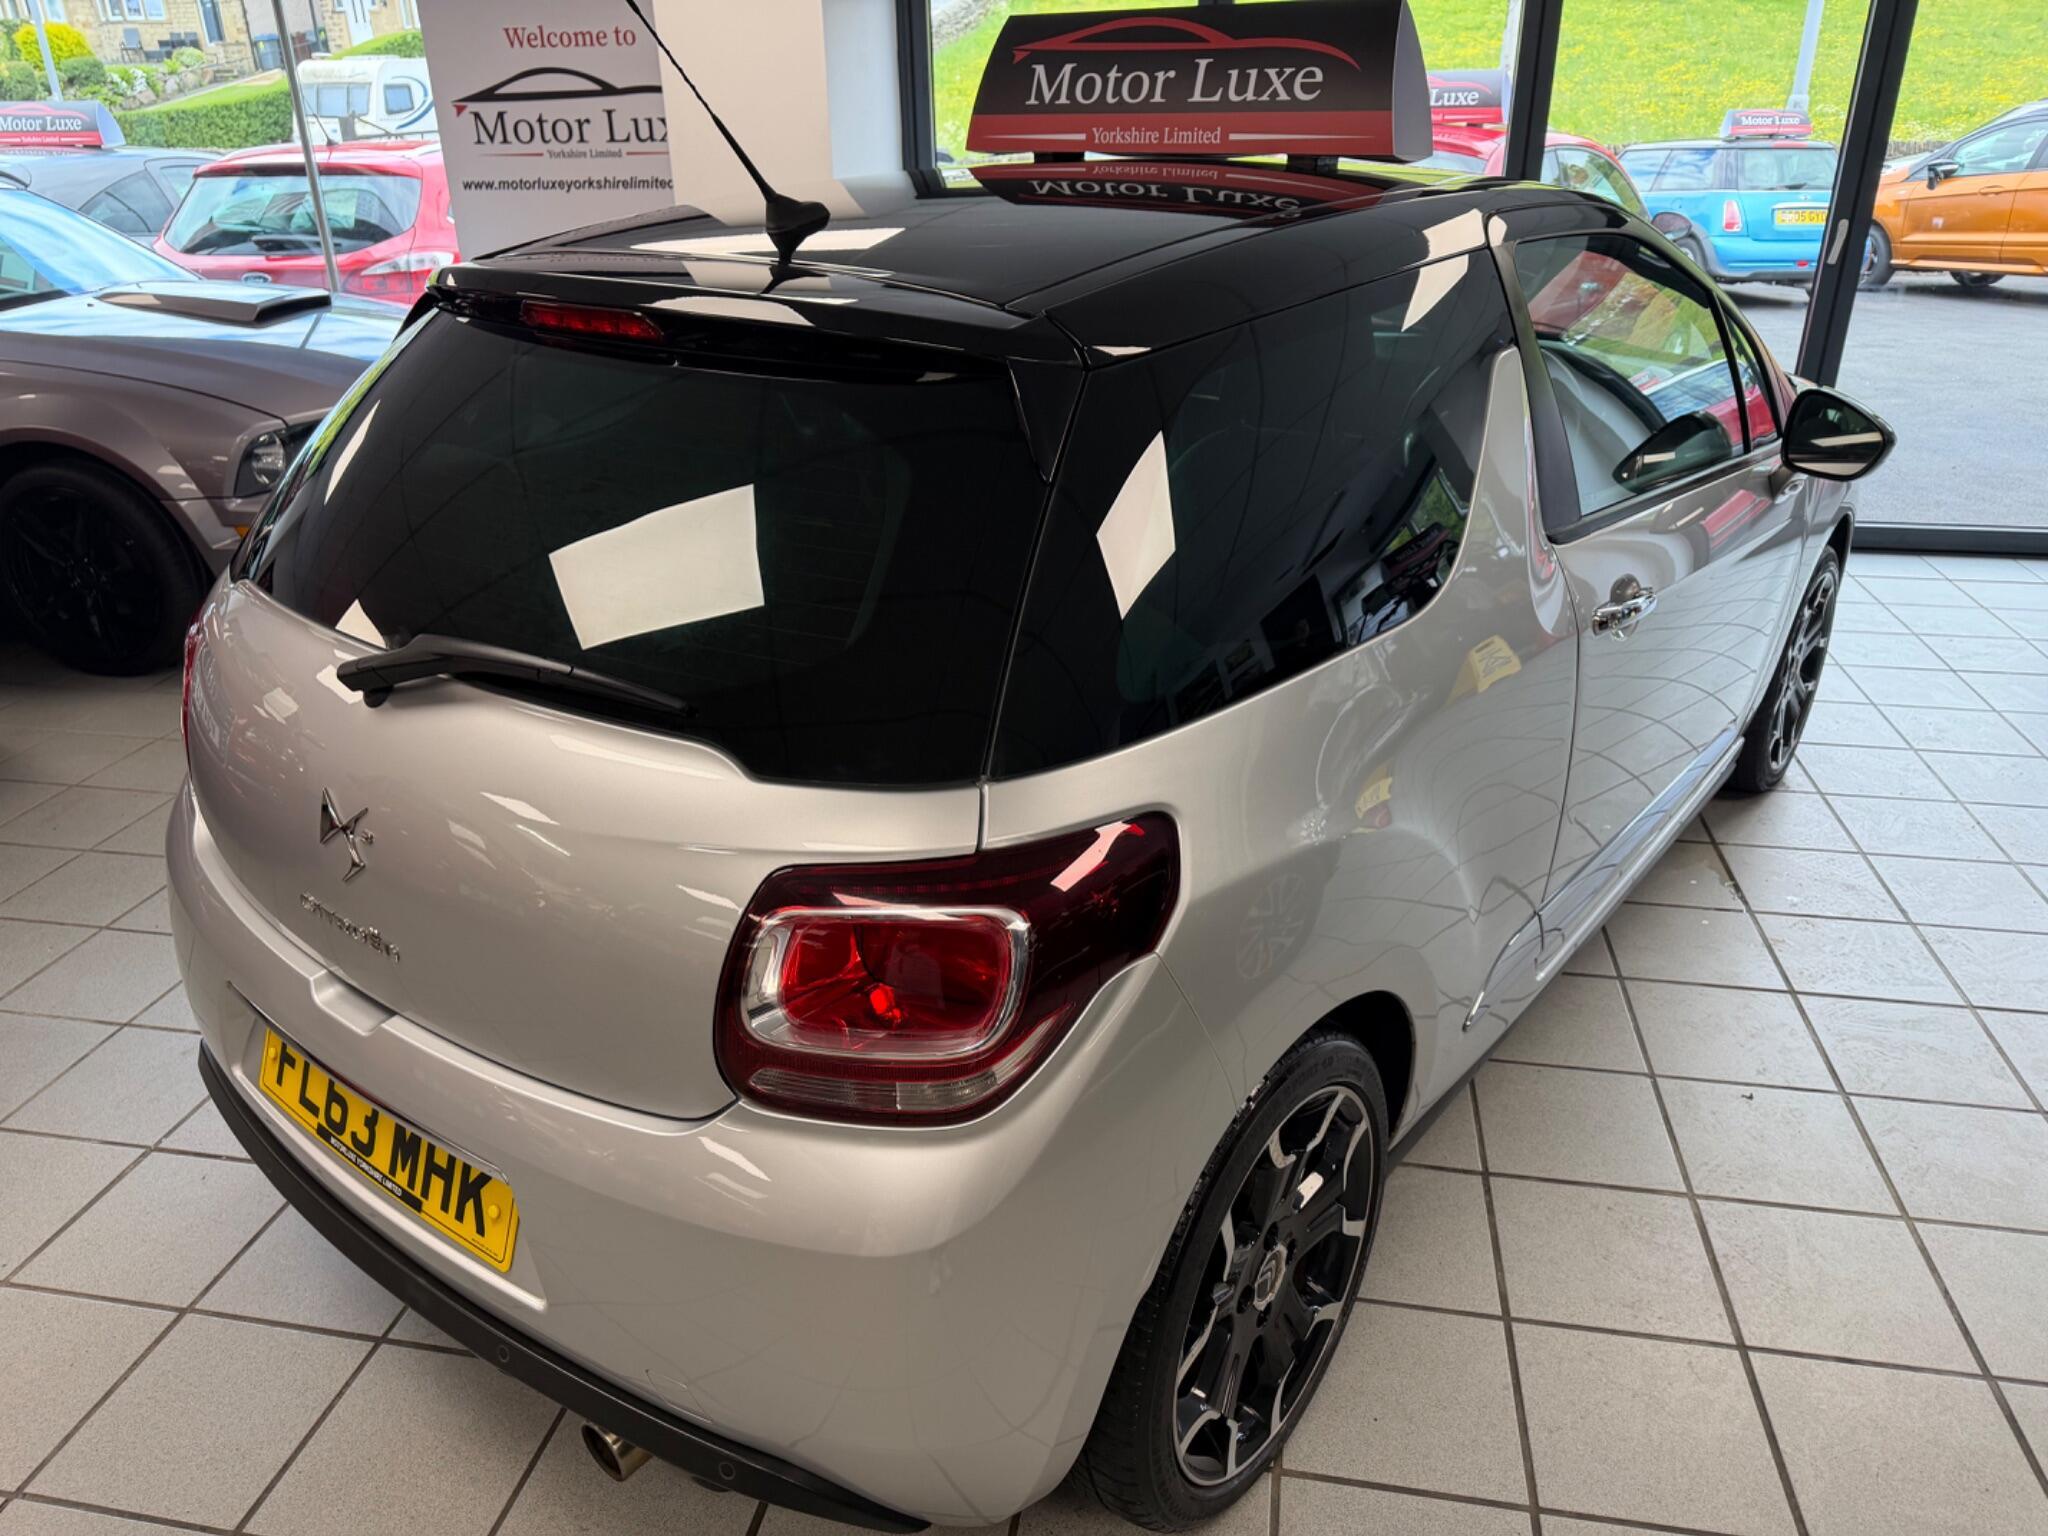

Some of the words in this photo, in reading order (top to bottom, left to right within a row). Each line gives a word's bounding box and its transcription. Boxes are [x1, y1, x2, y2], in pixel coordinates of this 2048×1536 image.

[504, 25, 608, 49] Welcome
[615, 25, 636, 46] to
[1025, 63, 1176, 105] Motor
[1187, 58, 1324, 102] Luxe
[1430, 88, 1480, 106] Luxe
[0, 115, 43, 131] Motor
[46, 115, 82, 131] Luxe
[470, 110, 591, 145] Motor
[1740, 115, 1773, 126] Motor
[1092, 127, 1160, 145] Yorkshire
[1163, 126, 1222, 144] Limited
[276, 1042, 380, 1157] FL63
[388, 1120, 493, 1238] MHK
